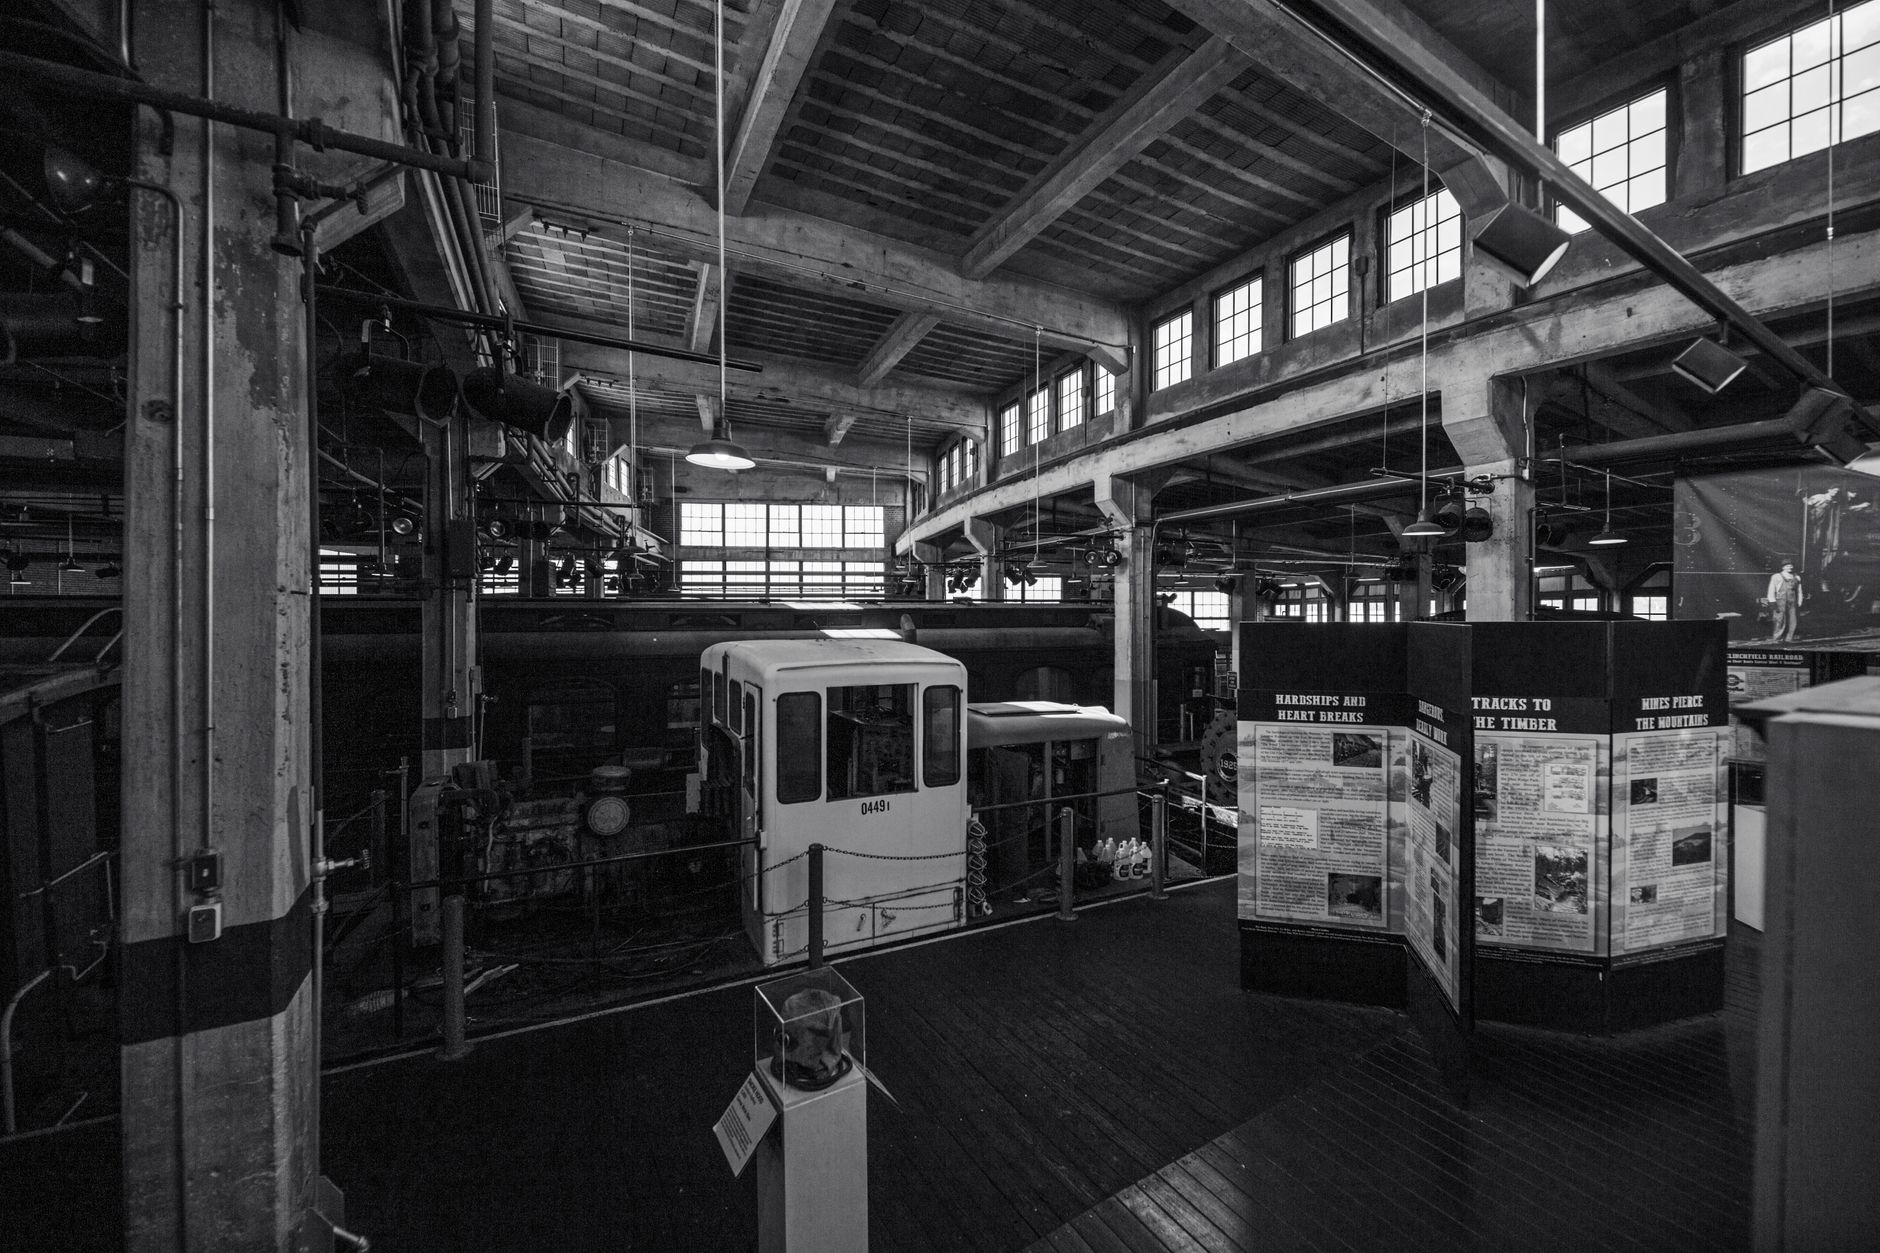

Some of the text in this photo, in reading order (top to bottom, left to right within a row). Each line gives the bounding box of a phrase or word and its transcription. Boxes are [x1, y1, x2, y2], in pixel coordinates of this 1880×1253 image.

[1275, 694, 1366, 707] HARDSHIPS AND
[1471, 697, 1552, 712] TRACKS TO
[1641, 695, 1704, 710] MINES PIERCE
[1278, 709, 1364, 723] HEART BREAKS
[1473, 716, 1558, 731] HE TIMBER
[1635, 713, 1709, 730] THE MOUNTAINS
[861, 799, 890, 816] 04491
